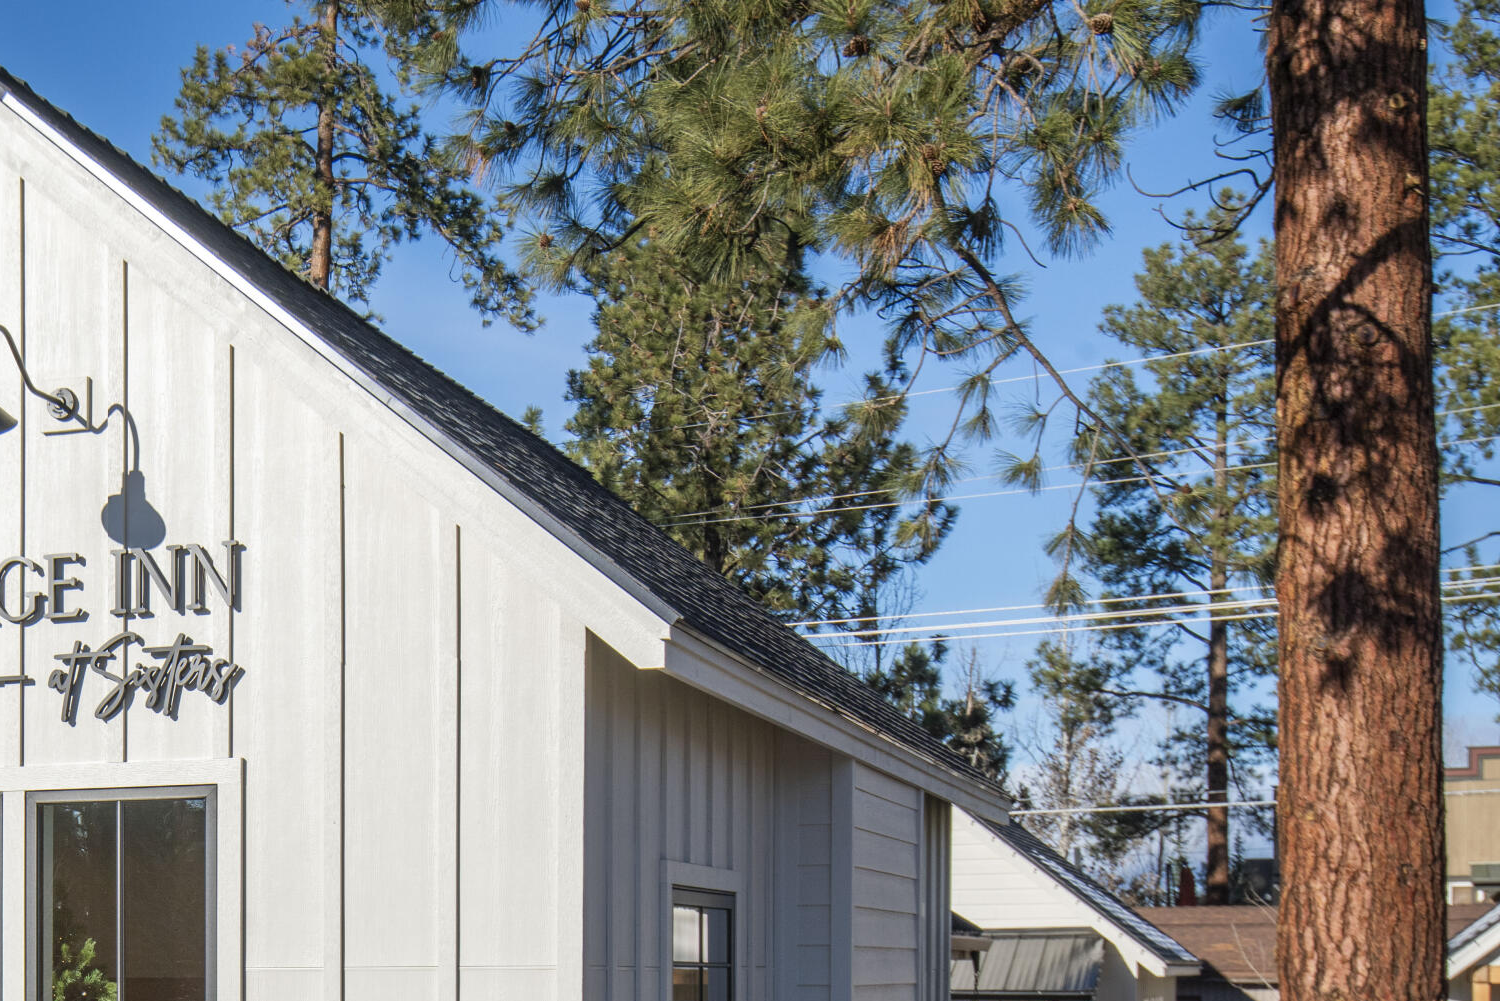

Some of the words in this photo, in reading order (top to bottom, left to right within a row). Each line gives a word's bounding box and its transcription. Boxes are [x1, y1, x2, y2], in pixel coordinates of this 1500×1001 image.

[110, 539, 241, 616] INN
[49, 640, 113, 723] at
[90, 631, 242, 720] Sisters
